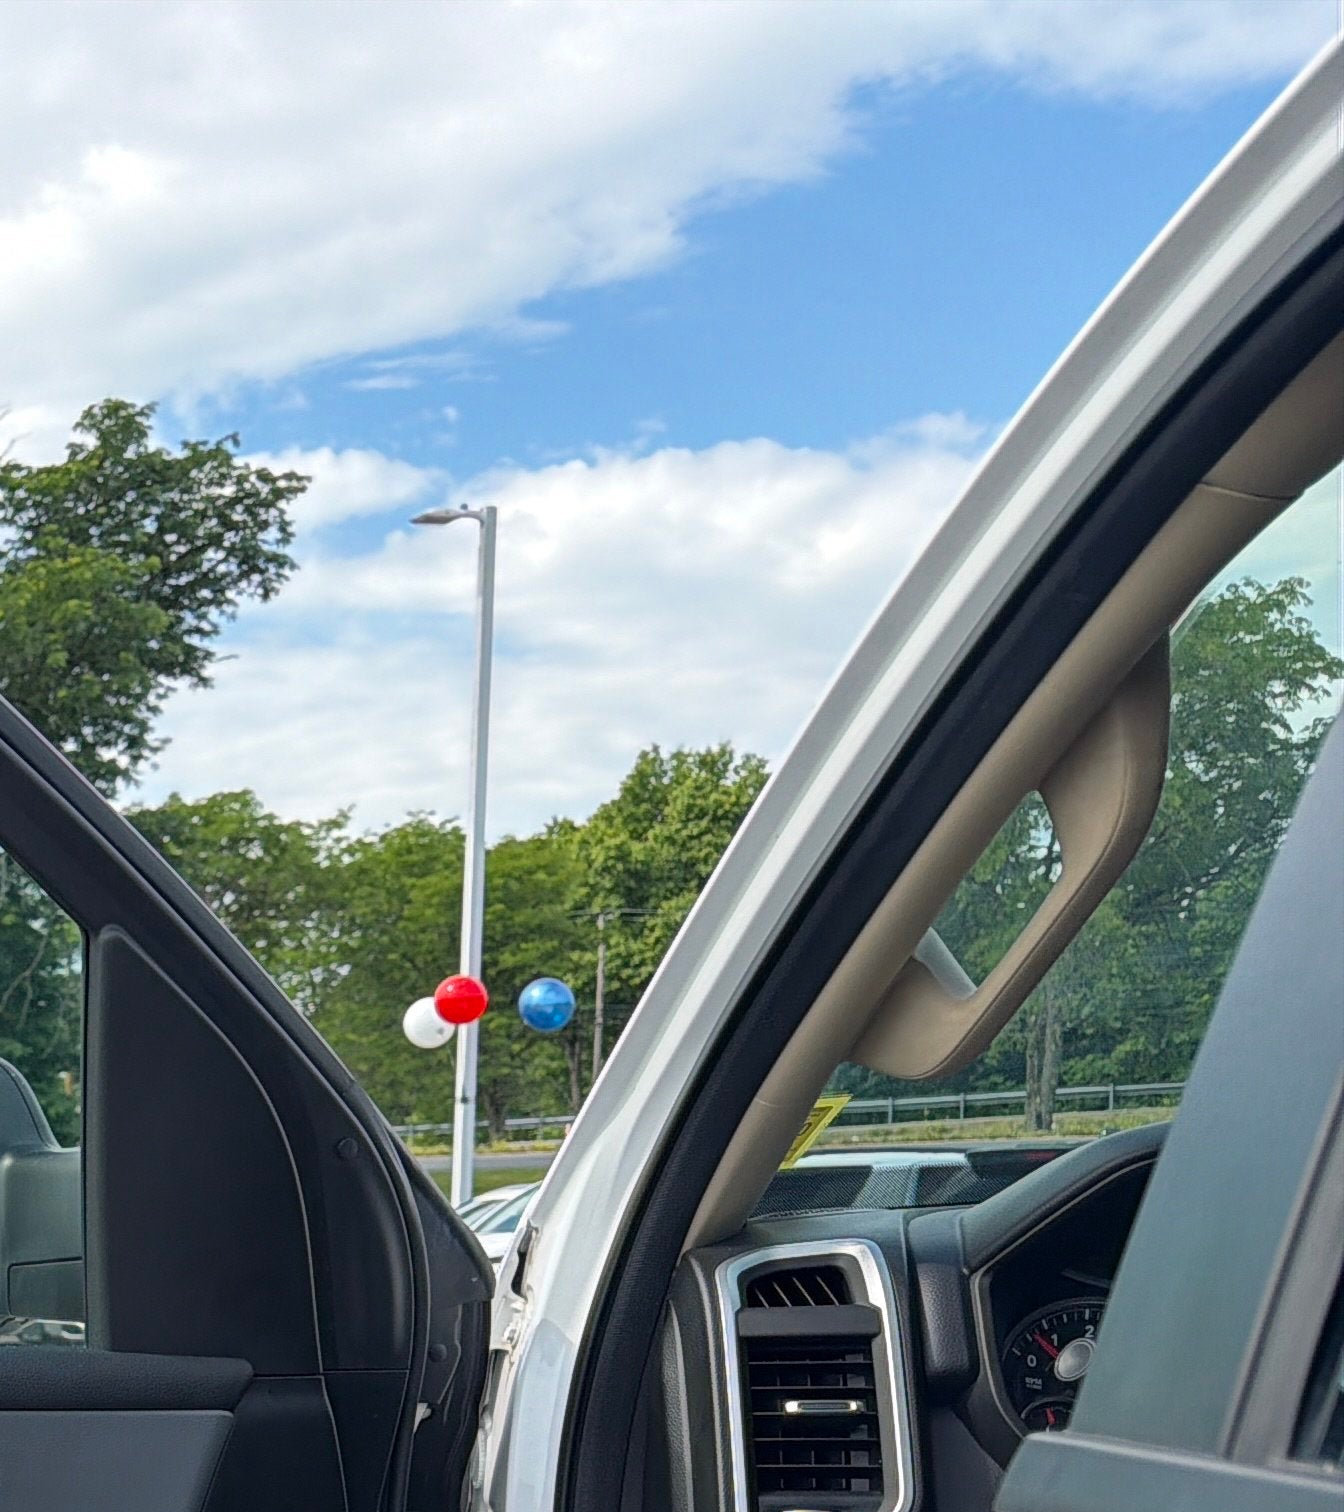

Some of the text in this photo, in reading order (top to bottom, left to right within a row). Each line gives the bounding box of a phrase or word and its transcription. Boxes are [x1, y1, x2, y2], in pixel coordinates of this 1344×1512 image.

[1084, 1325, 1094, 1338] 2
[1051, 1333, 1058, 1346] 1
[1027, 1355, 1037, 1367] 0
